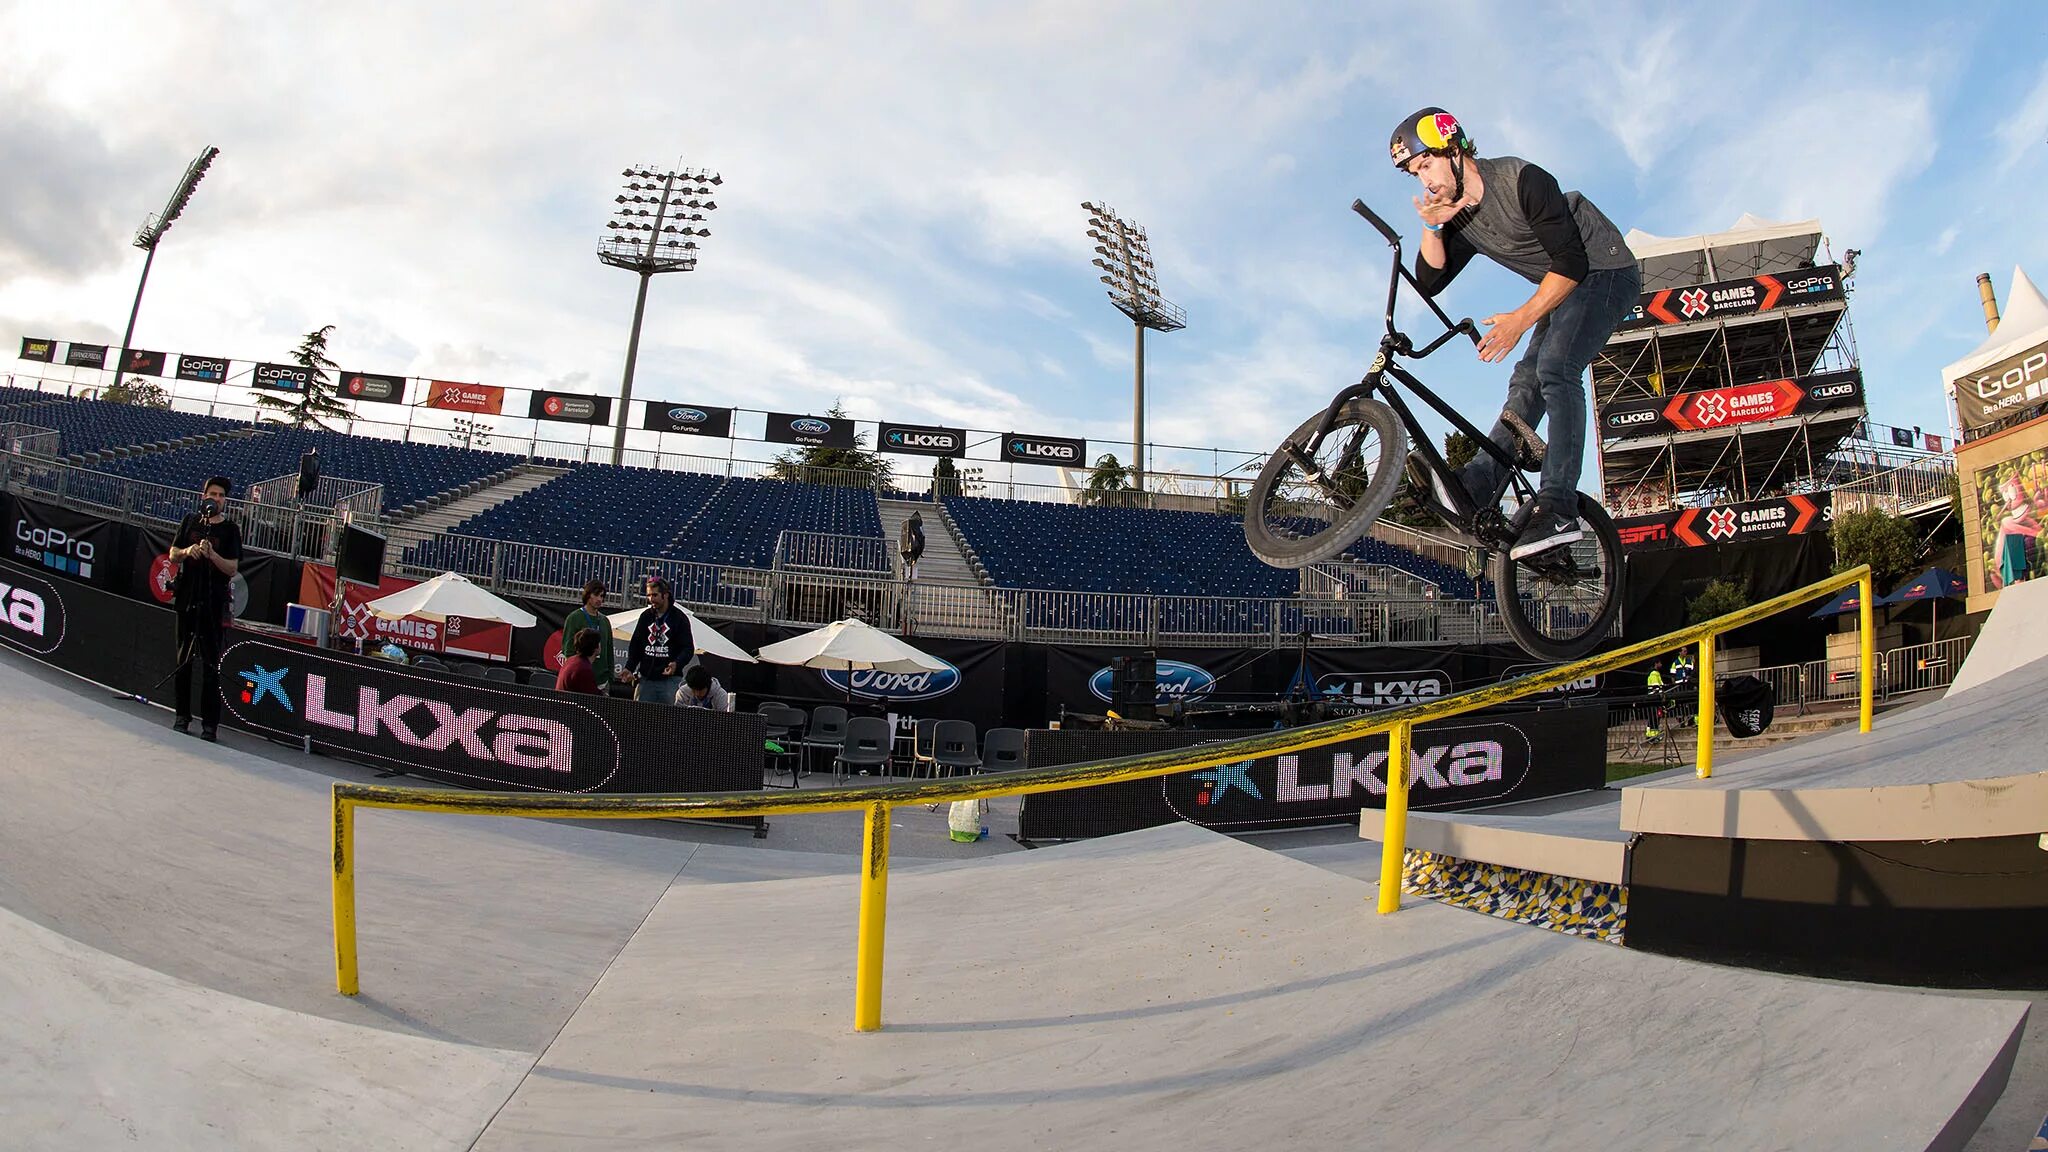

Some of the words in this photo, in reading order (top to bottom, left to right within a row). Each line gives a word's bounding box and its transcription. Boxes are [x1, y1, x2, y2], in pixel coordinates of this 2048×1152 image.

[1787, 276, 1832, 290] GoPro
[1712, 286, 1755, 302] GAMES
[1713, 299, 1757, 310] BARCELONA
[182, 358, 224, 372] GoPro
[258, 366, 307, 381] GoPro
[462, 392, 487, 402] GAMES
[1729, 391, 1774, 409] GAMES
[675, 409, 700, 421] Ford
[1731, 405, 1775, 417] BARCELONA
[1983, 405, 1992, 414] Be
[680, 425, 700, 433] Further
[797, 420, 823, 432] Ford
[804, 436, 823, 444] Further
[1741, 506, 1786, 524] GAMES
[1741, 520, 1787, 532] BARCELONA
[16, 519, 94, 560] GoPro
[375, 617, 438, 640] GAMES
[374, 633, 436, 651] BRCELONA
